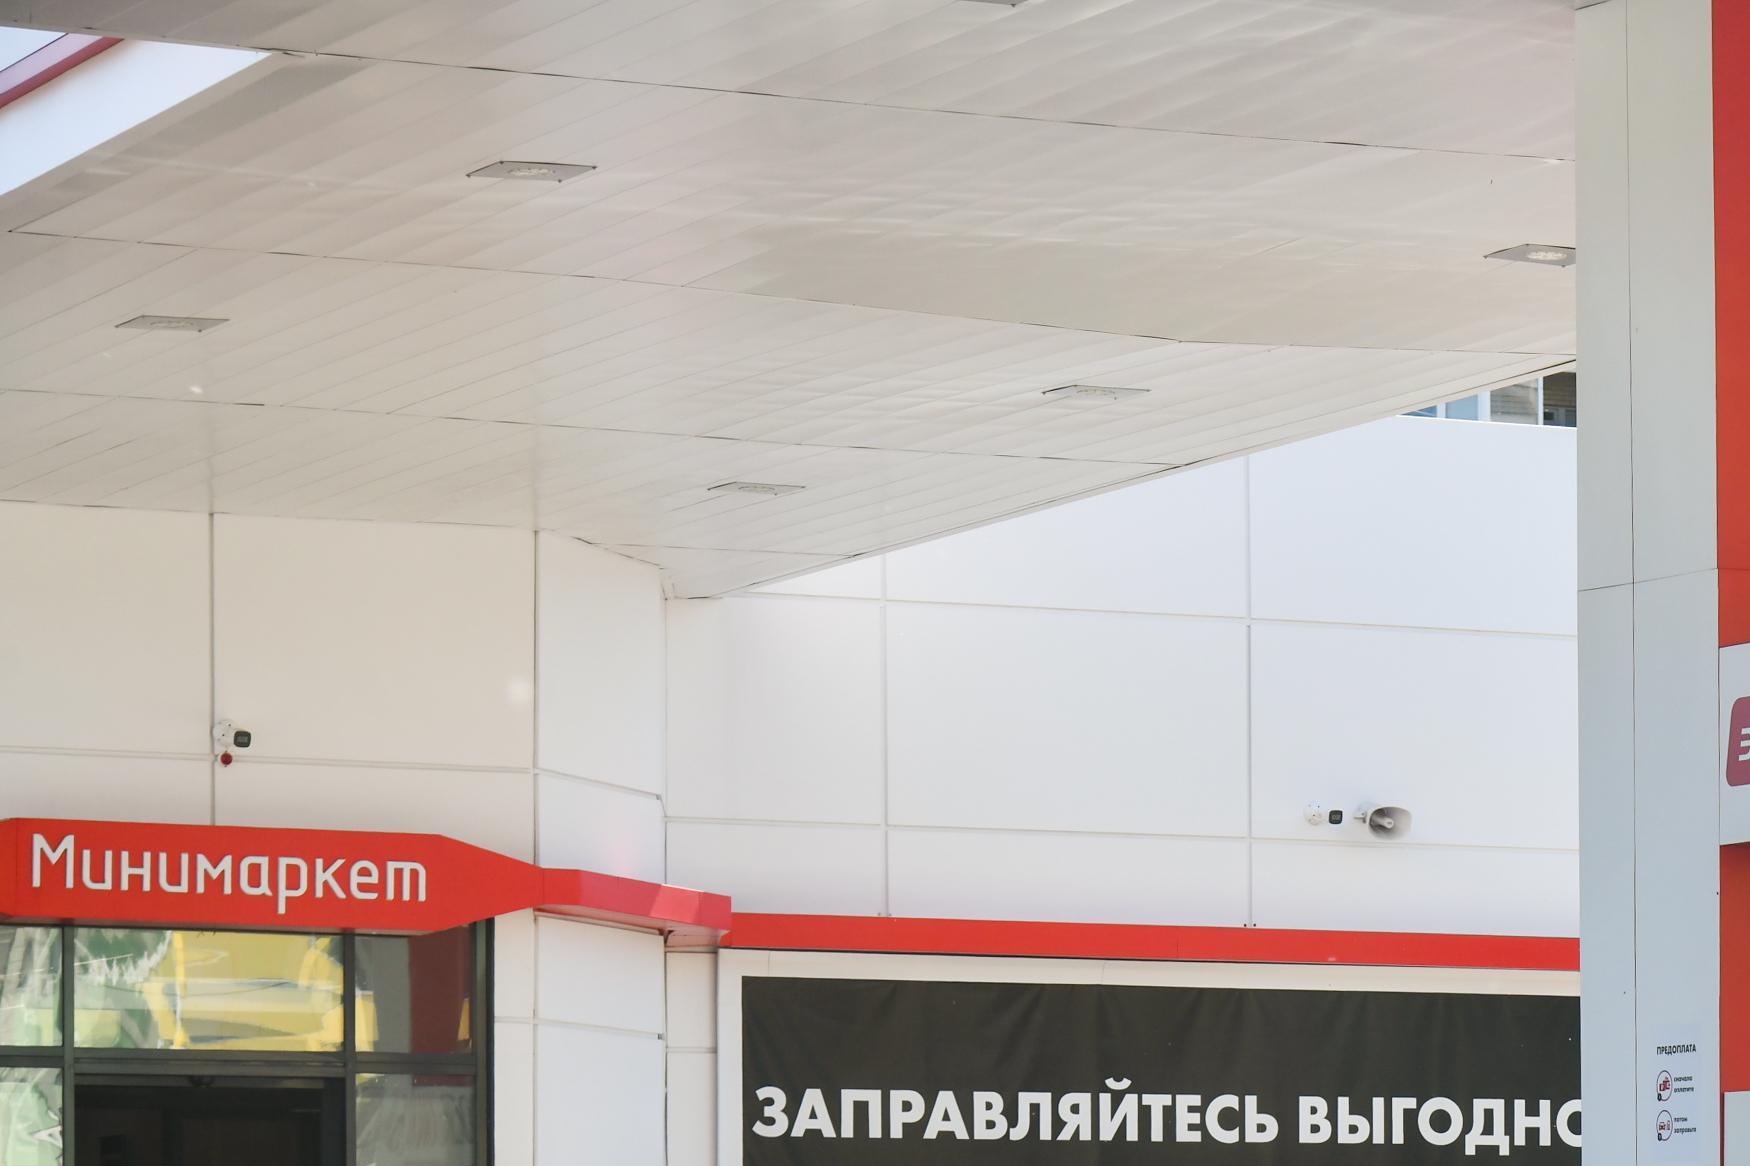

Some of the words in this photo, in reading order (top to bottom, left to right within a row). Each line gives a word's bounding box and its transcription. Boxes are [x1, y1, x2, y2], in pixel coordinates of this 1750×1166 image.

[31, 833, 427, 914] Минимаркет
[1656, 1044, 1697, 1056] ПРЕДОПЛАТА
[752, 1078, 1279, 1145] ЗАПРАВЛЯЙТЕСЬ
